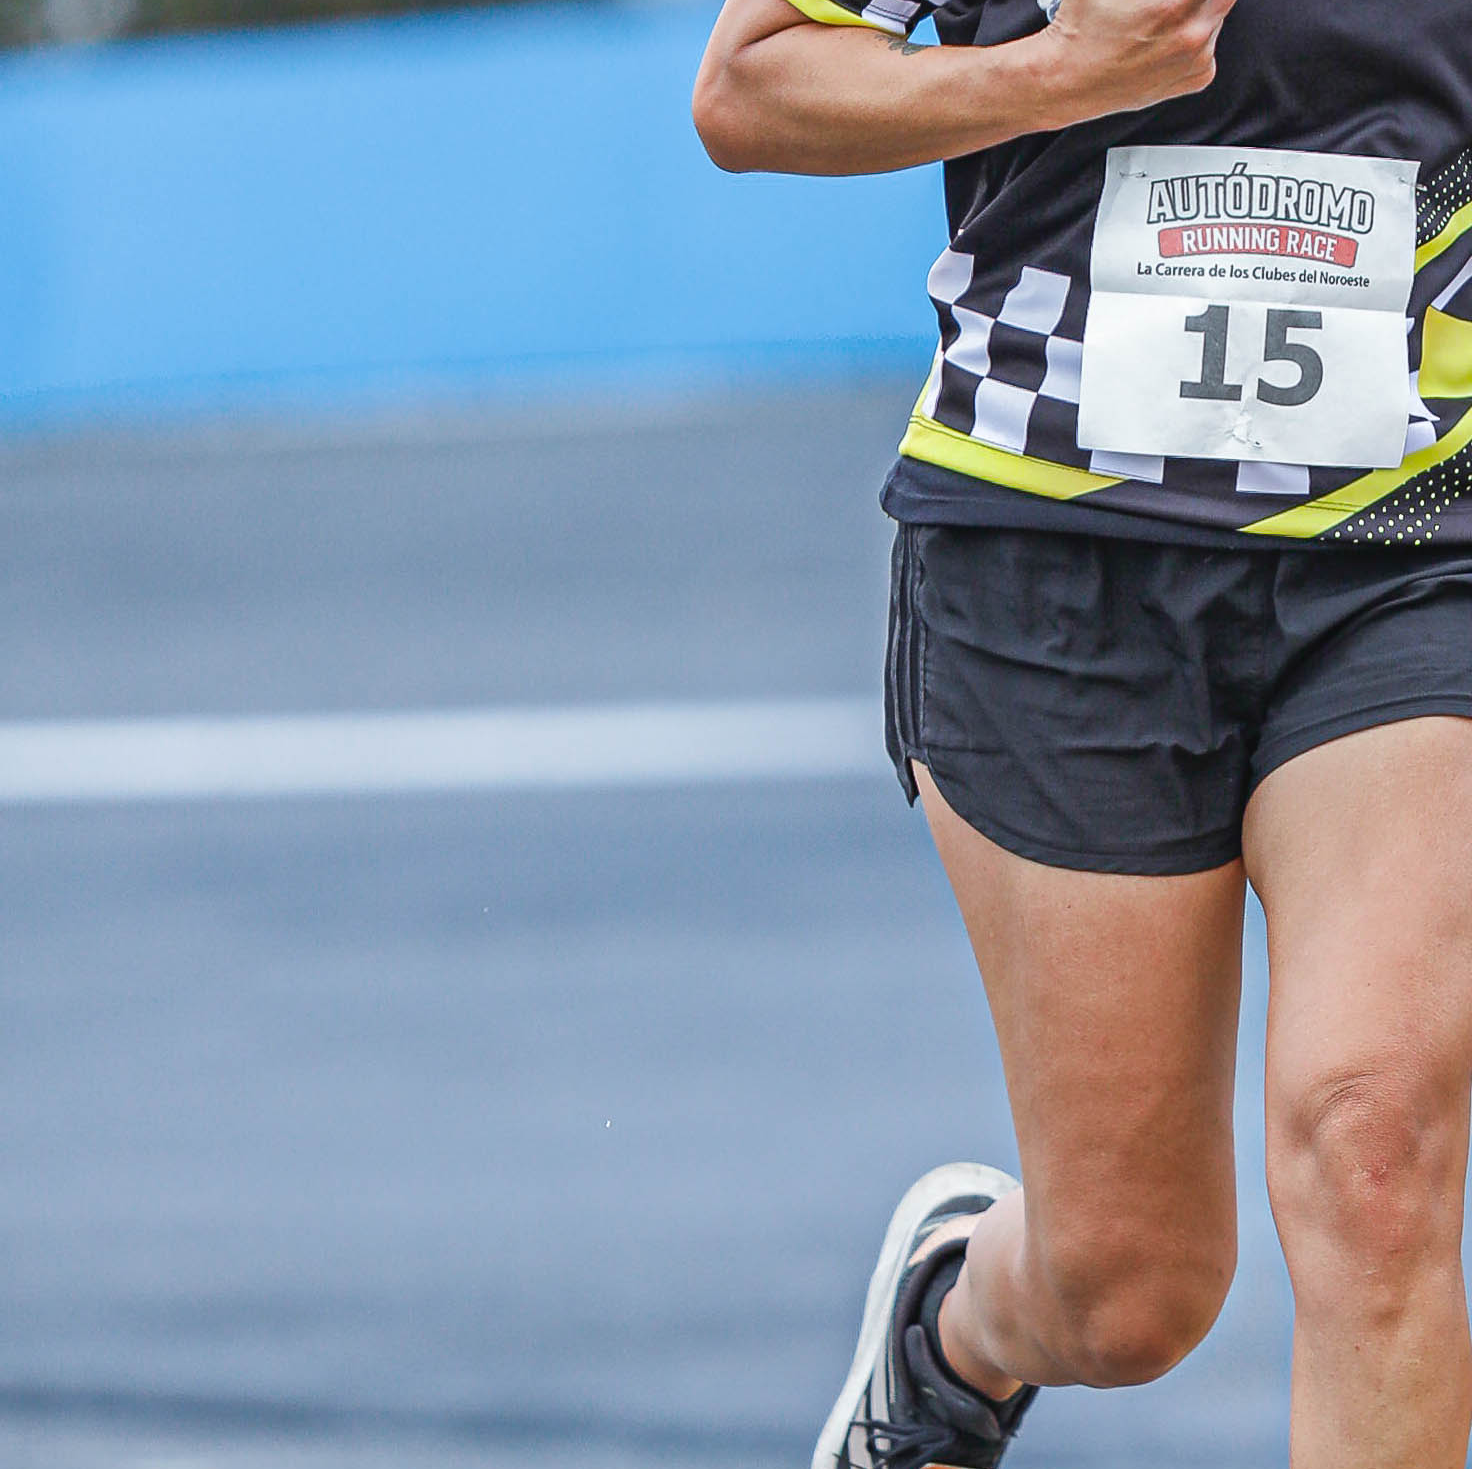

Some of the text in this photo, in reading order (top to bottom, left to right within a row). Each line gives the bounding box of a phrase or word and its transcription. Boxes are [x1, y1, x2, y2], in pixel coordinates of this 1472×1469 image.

[1146, 162, 1375, 234] AUTÓDROMO
[1182, 227, 1338, 261] RUNNING RACE
[1137, 262, 1370, 287] La Carrera de los Clubes del Noroeste
[1179, 304, 1324, 407] 15
